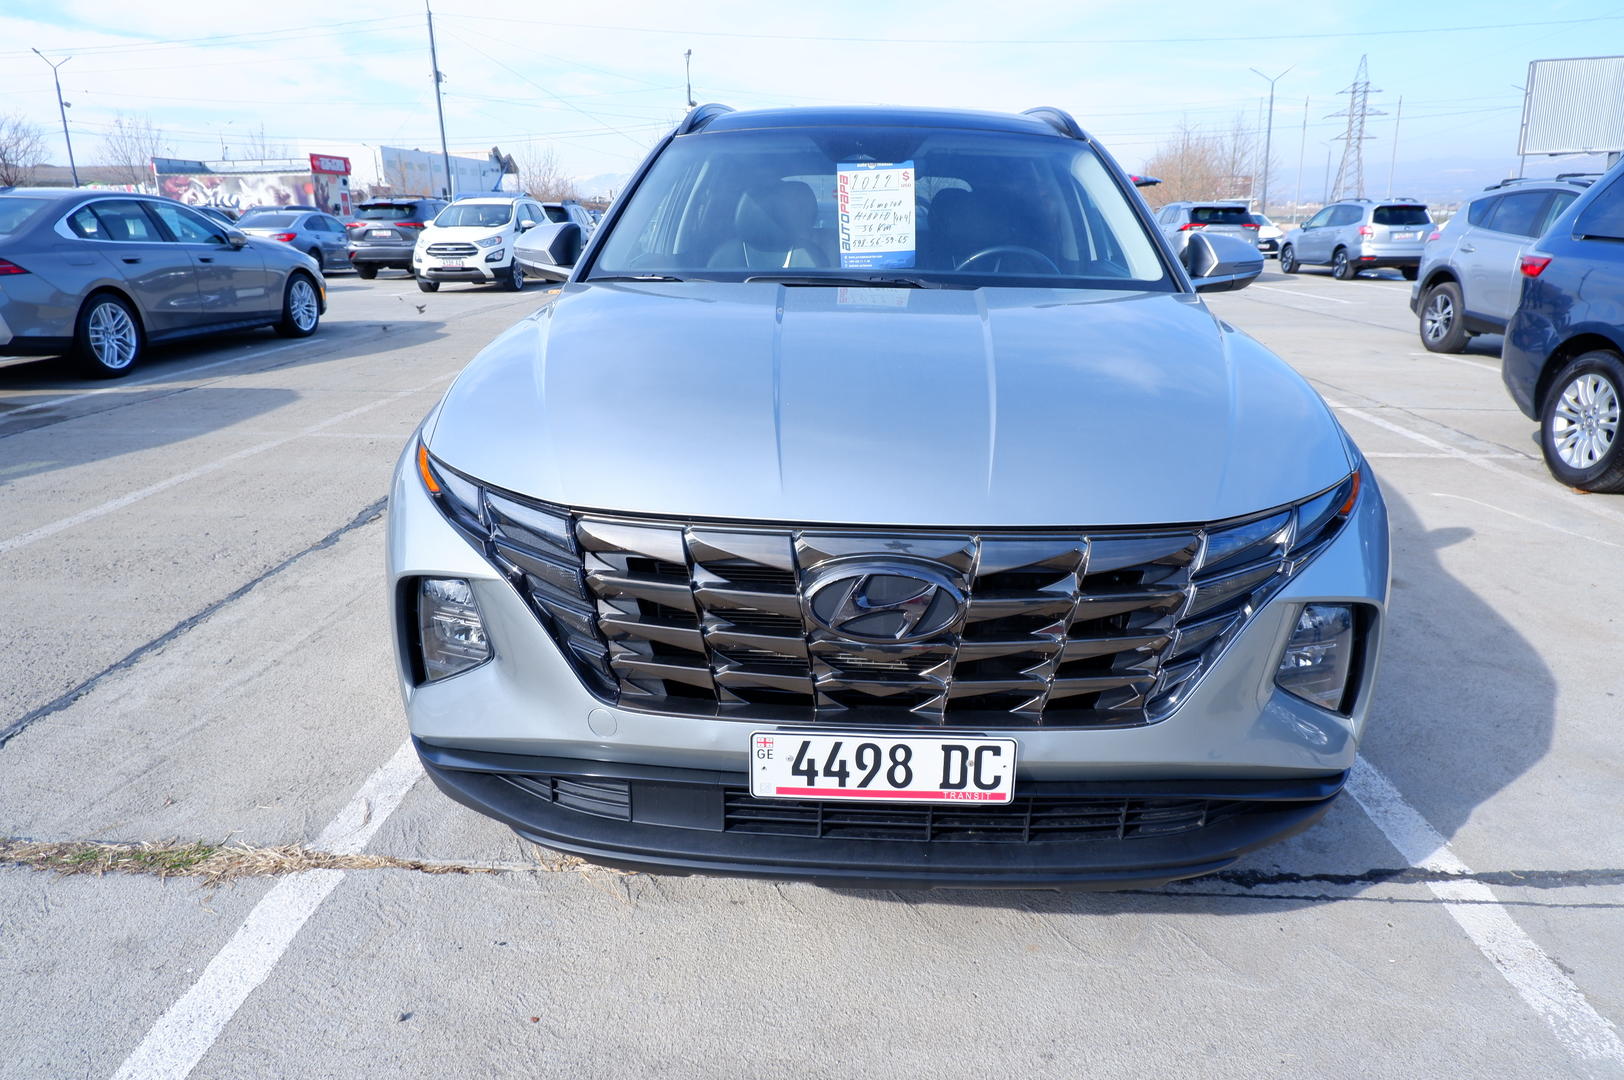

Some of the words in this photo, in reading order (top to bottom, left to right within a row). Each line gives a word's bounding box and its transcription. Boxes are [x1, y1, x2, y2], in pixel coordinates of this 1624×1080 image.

[757, 749, 774, 760] GE
[791, 740, 913, 789] 4498
[939, 743, 1002, 790] DC
[943, 791, 992, 801] TRANSIT
